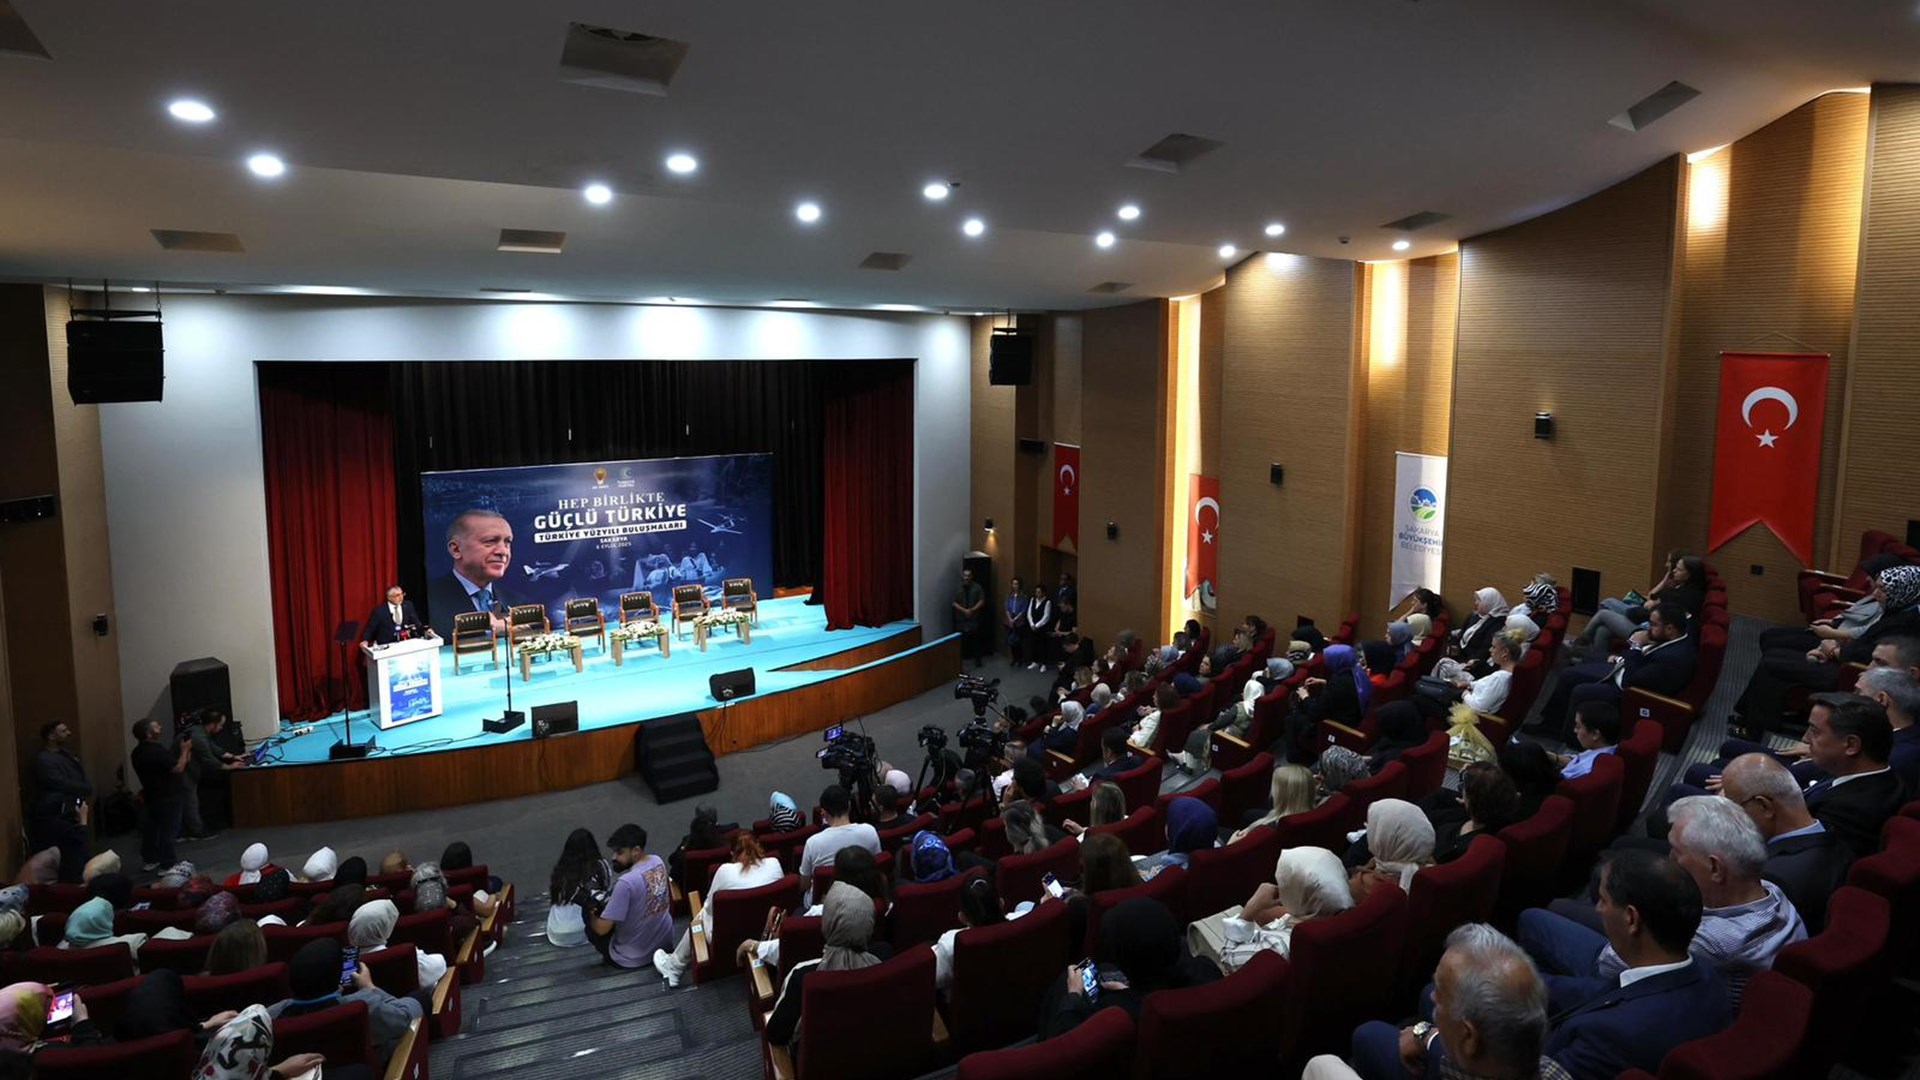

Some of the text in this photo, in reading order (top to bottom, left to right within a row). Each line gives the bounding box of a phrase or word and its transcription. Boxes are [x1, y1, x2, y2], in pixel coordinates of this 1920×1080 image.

[558, 492, 665, 510] HEP BİRLİKTE
[534, 503, 687, 530] GÜÇLÜ TÜRKİYE
[539, 521, 683, 541] TÜRKİYE YÜZYILI BULUŞMALARI
[1405, 524, 1439, 536] SAKARYA
